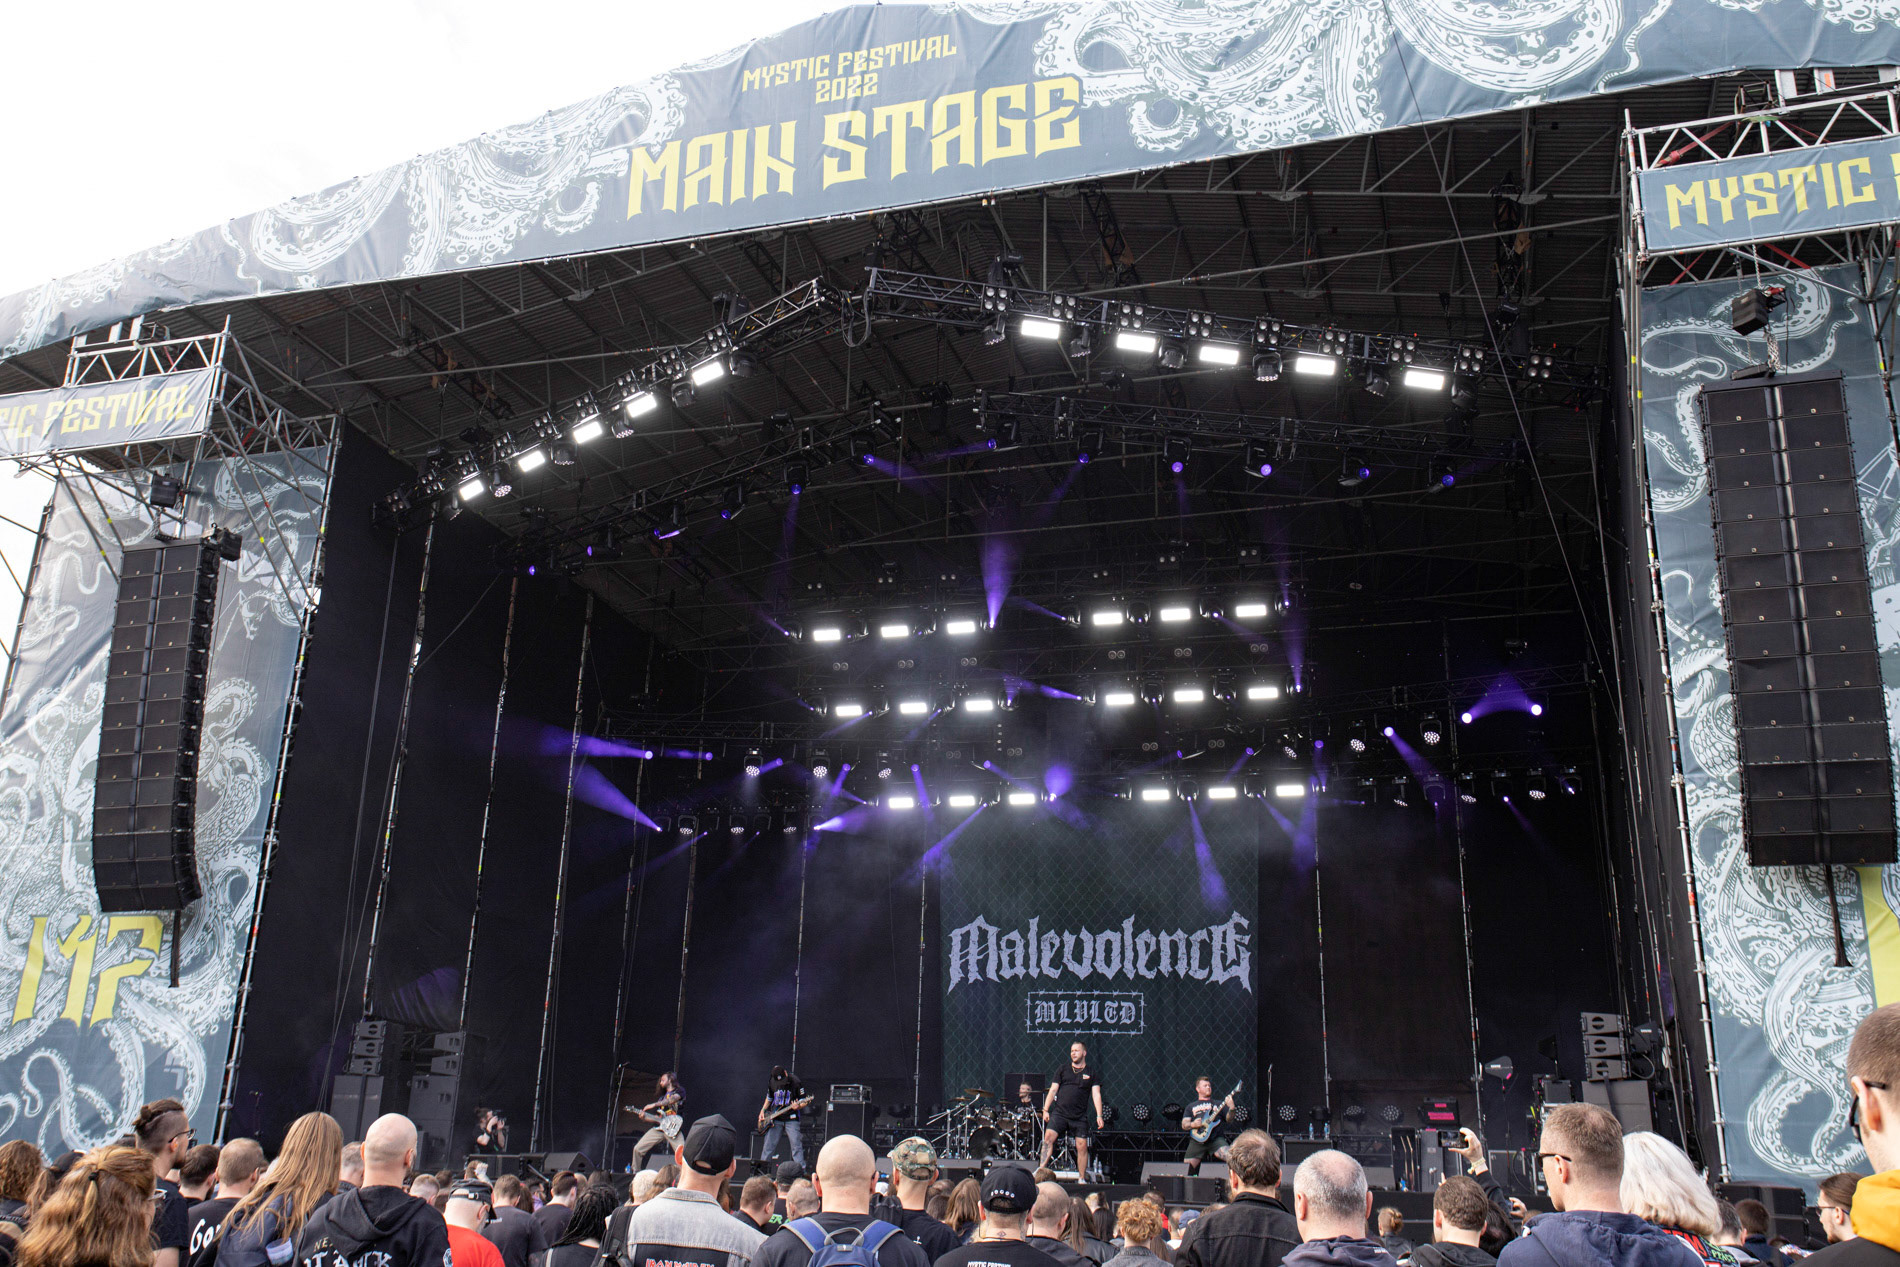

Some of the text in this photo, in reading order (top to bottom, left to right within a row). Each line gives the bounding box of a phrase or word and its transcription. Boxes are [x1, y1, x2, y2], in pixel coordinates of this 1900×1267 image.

[741, 34, 957, 92] MYSTIC FESTIVAL
[815, 72, 879, 104] 2022
[626, 74, 1082, 220] MAIN STAGE
[1664, 157, 1877, 230] MYSTIC
[40, 384, 196, 442] FESTIVAL
